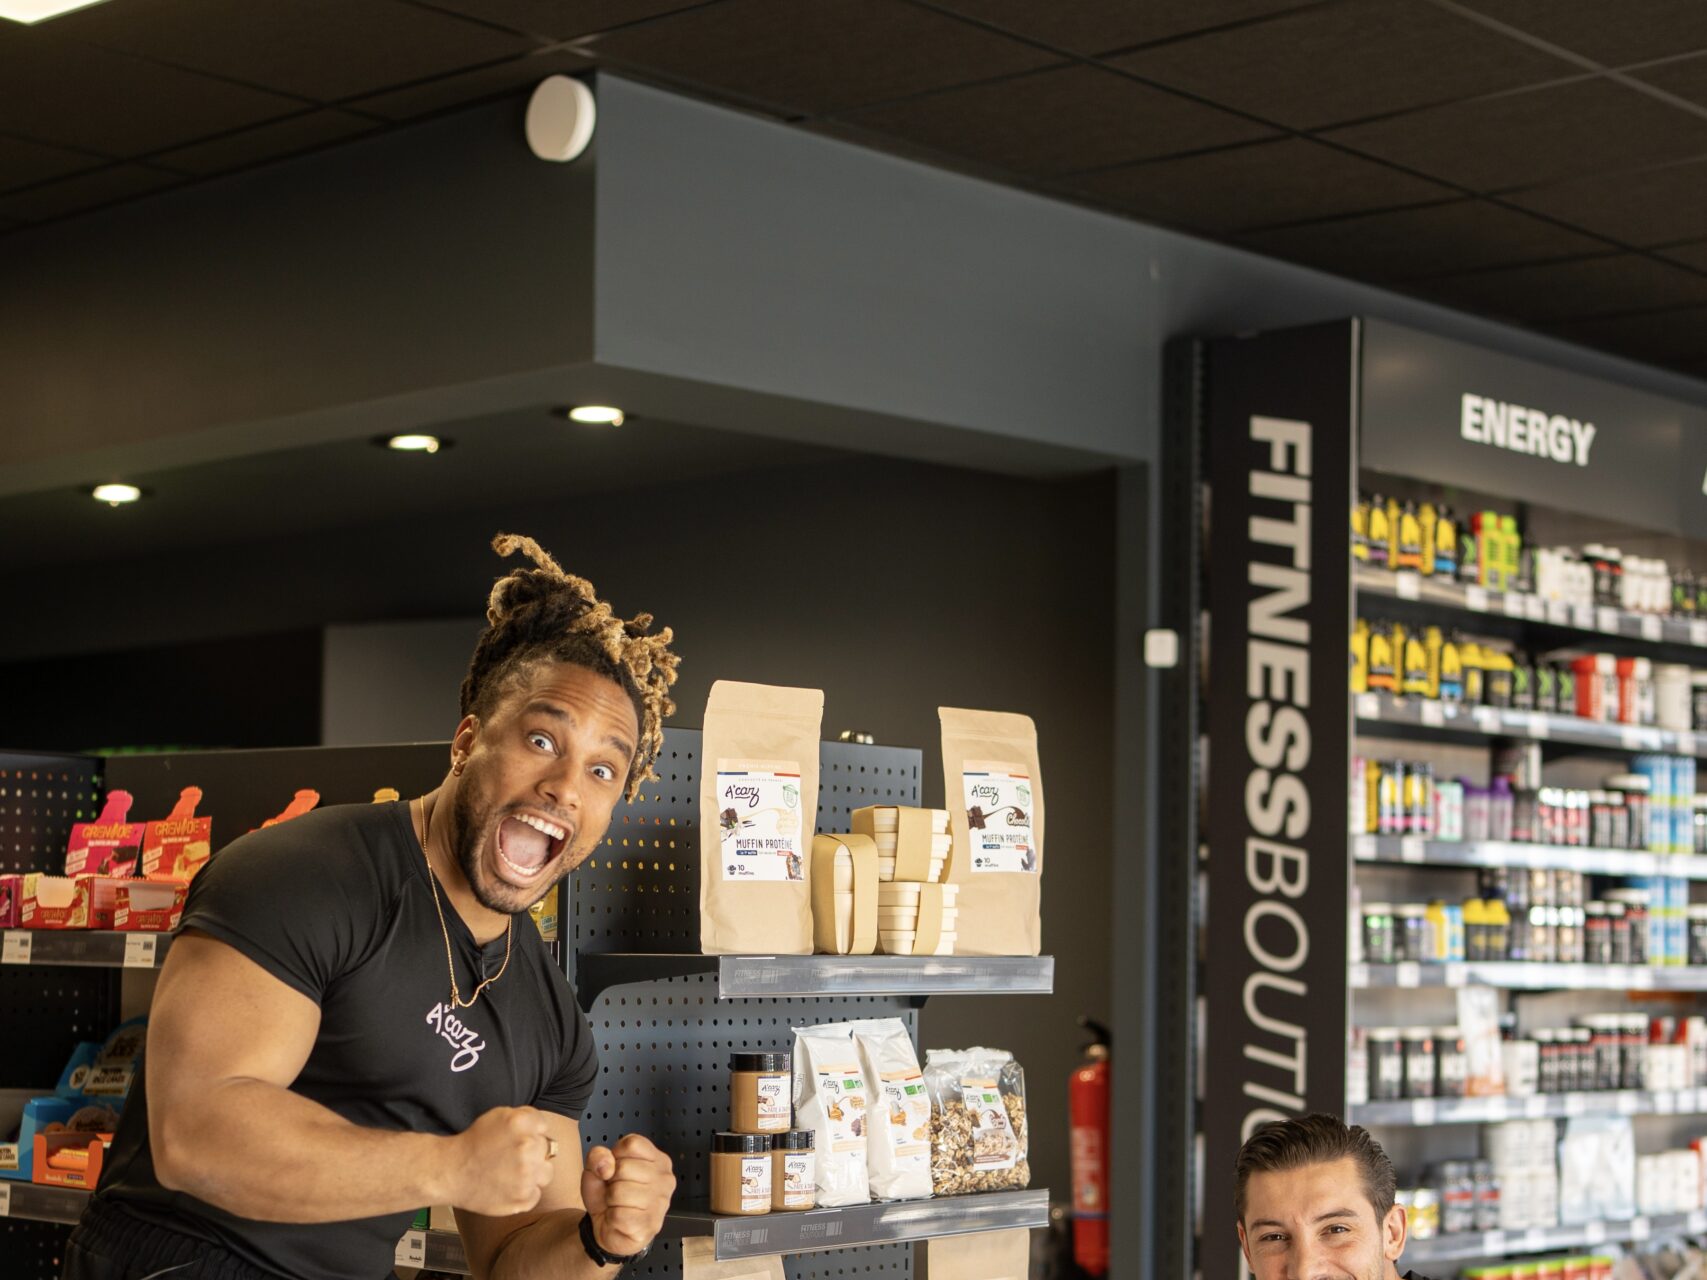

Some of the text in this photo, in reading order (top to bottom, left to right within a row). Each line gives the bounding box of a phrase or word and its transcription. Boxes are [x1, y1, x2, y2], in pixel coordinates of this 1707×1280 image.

[1460, 391, 1597, 467] ENERGY
[82, 822, 133, 839] GRENADE
[155, 818, 200, 837] GRENADE
[736, 839, 763, 849] MUFFIN
[982, 834, 1004, 843] MUFFIN
[800, 1222, 826, 1233] FITNESS
[723, 1230, 751, 1241] FITNESS
